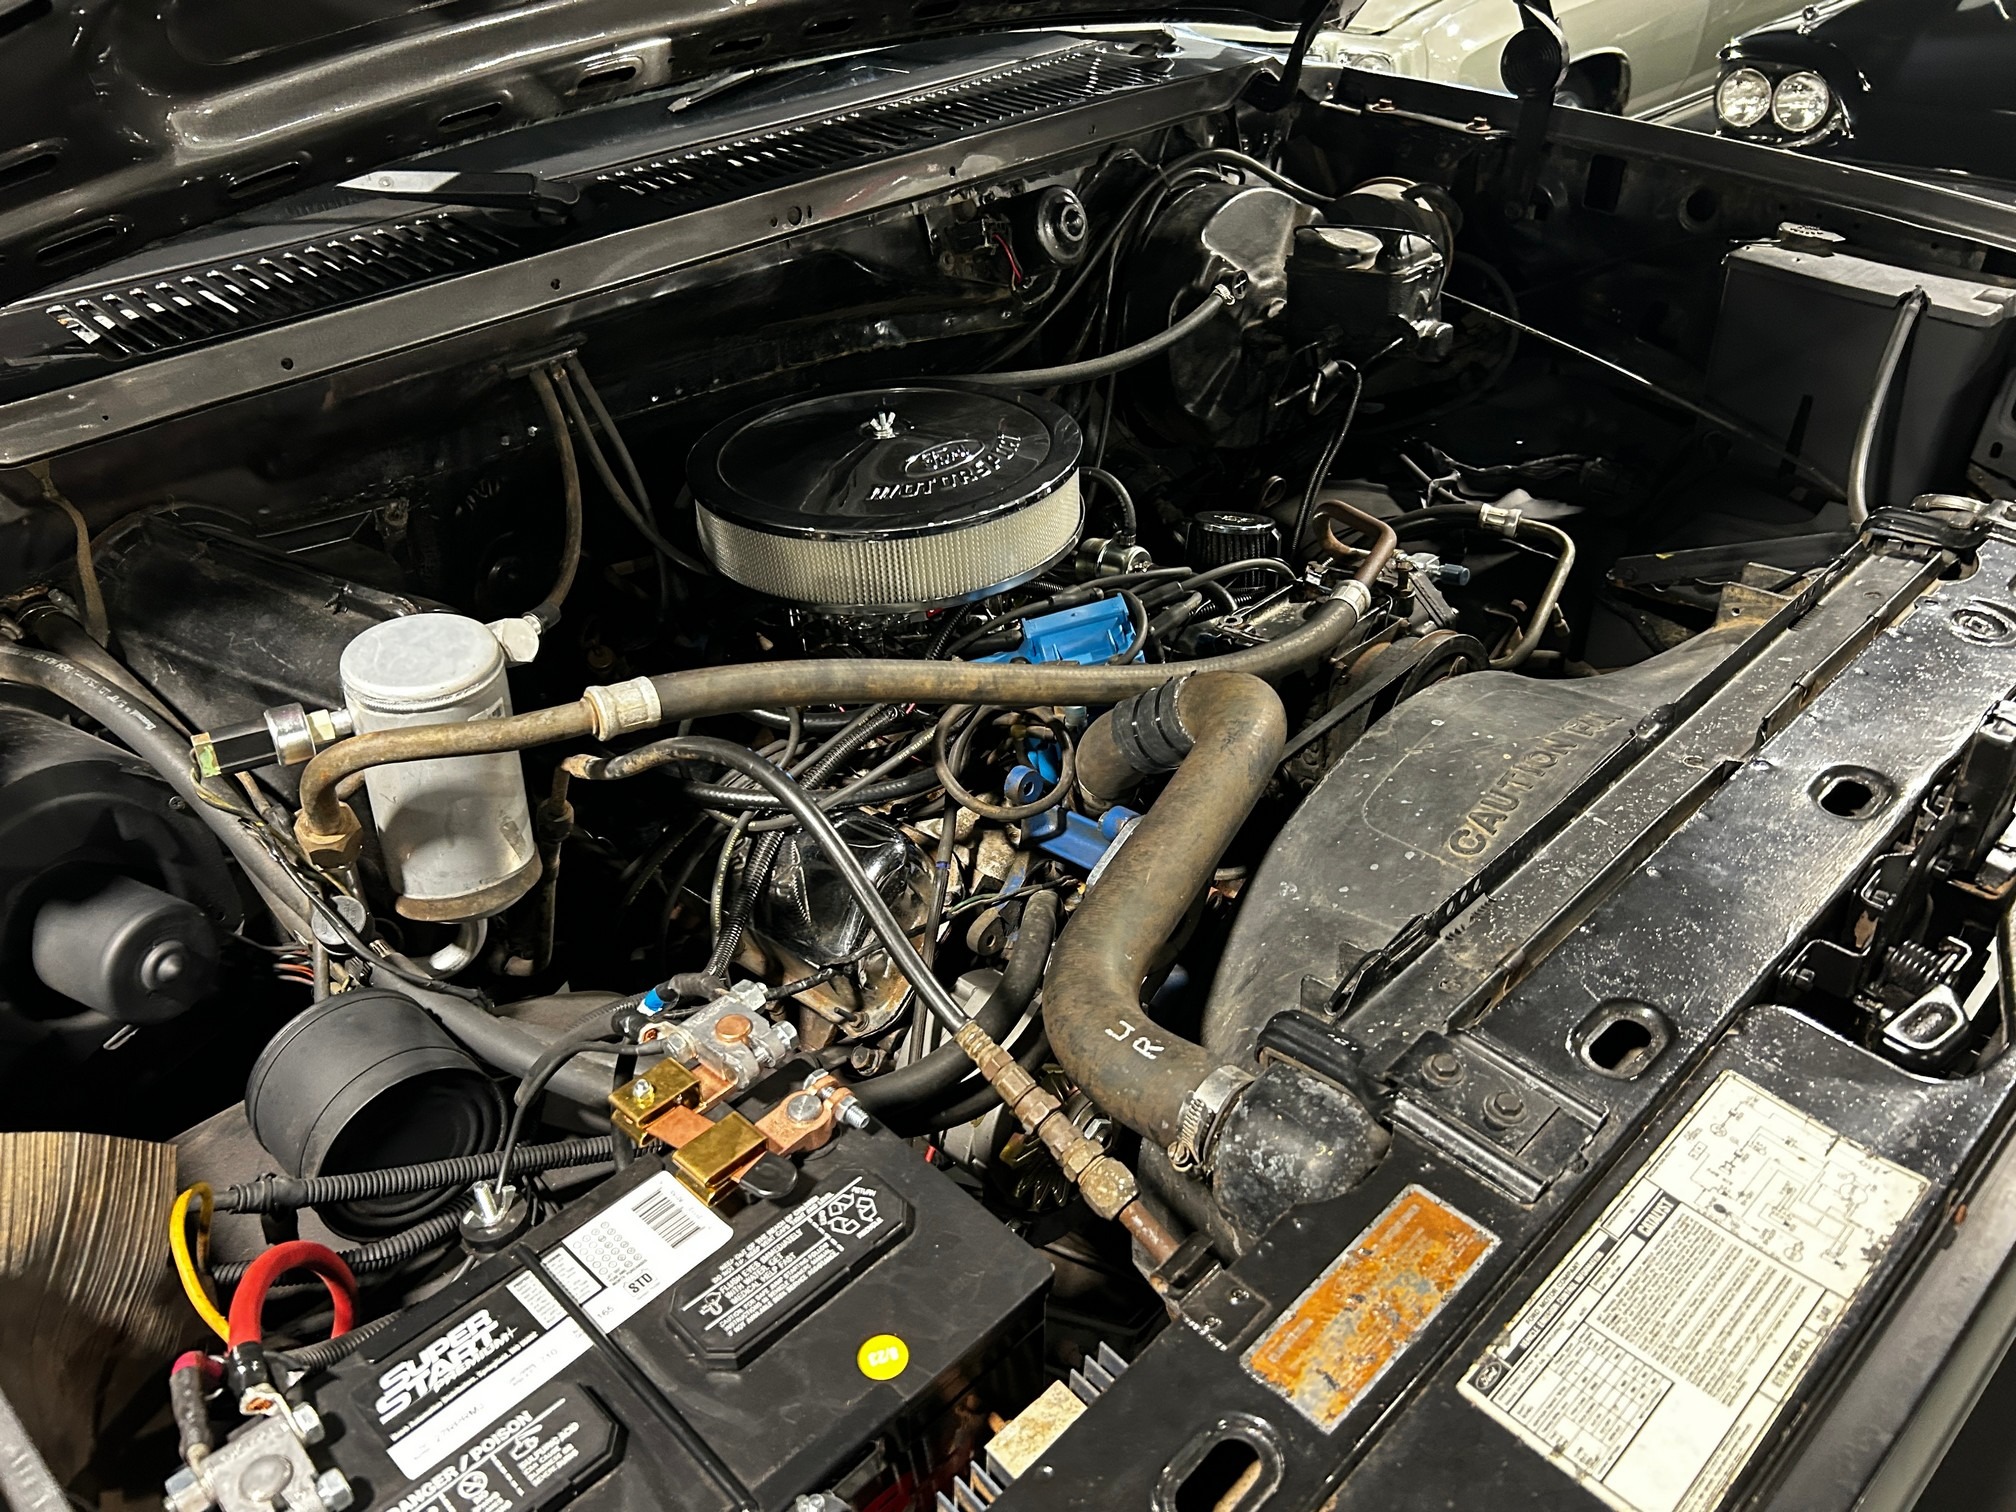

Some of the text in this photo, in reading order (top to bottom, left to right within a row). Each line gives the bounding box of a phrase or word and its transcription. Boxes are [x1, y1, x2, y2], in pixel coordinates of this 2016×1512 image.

[867, 434, 1022, 500] MOTORSPORT
[1449, 738, 1579, 856] CAUTION
[1132, 1036, 1165, 1060] R
[1636, 1197, 1676, 1239] CATALYST
[628, 1272, 653, 1294] STD
[719, 1228, 803, 1294] FLUSH EYES IMMEDIATELY
[725, 1283, 744, 1299] WITH
[766, 1252, 783, 1266] GET
[730, 1252, 796, 1304] MEDICAL HELP FAST
[1525, 1260, 1580, 1325] FORD MOTOR COMPANY
[376, 1320, 499, 1425] START
[379, 1309, 495, 1391] SUPER
